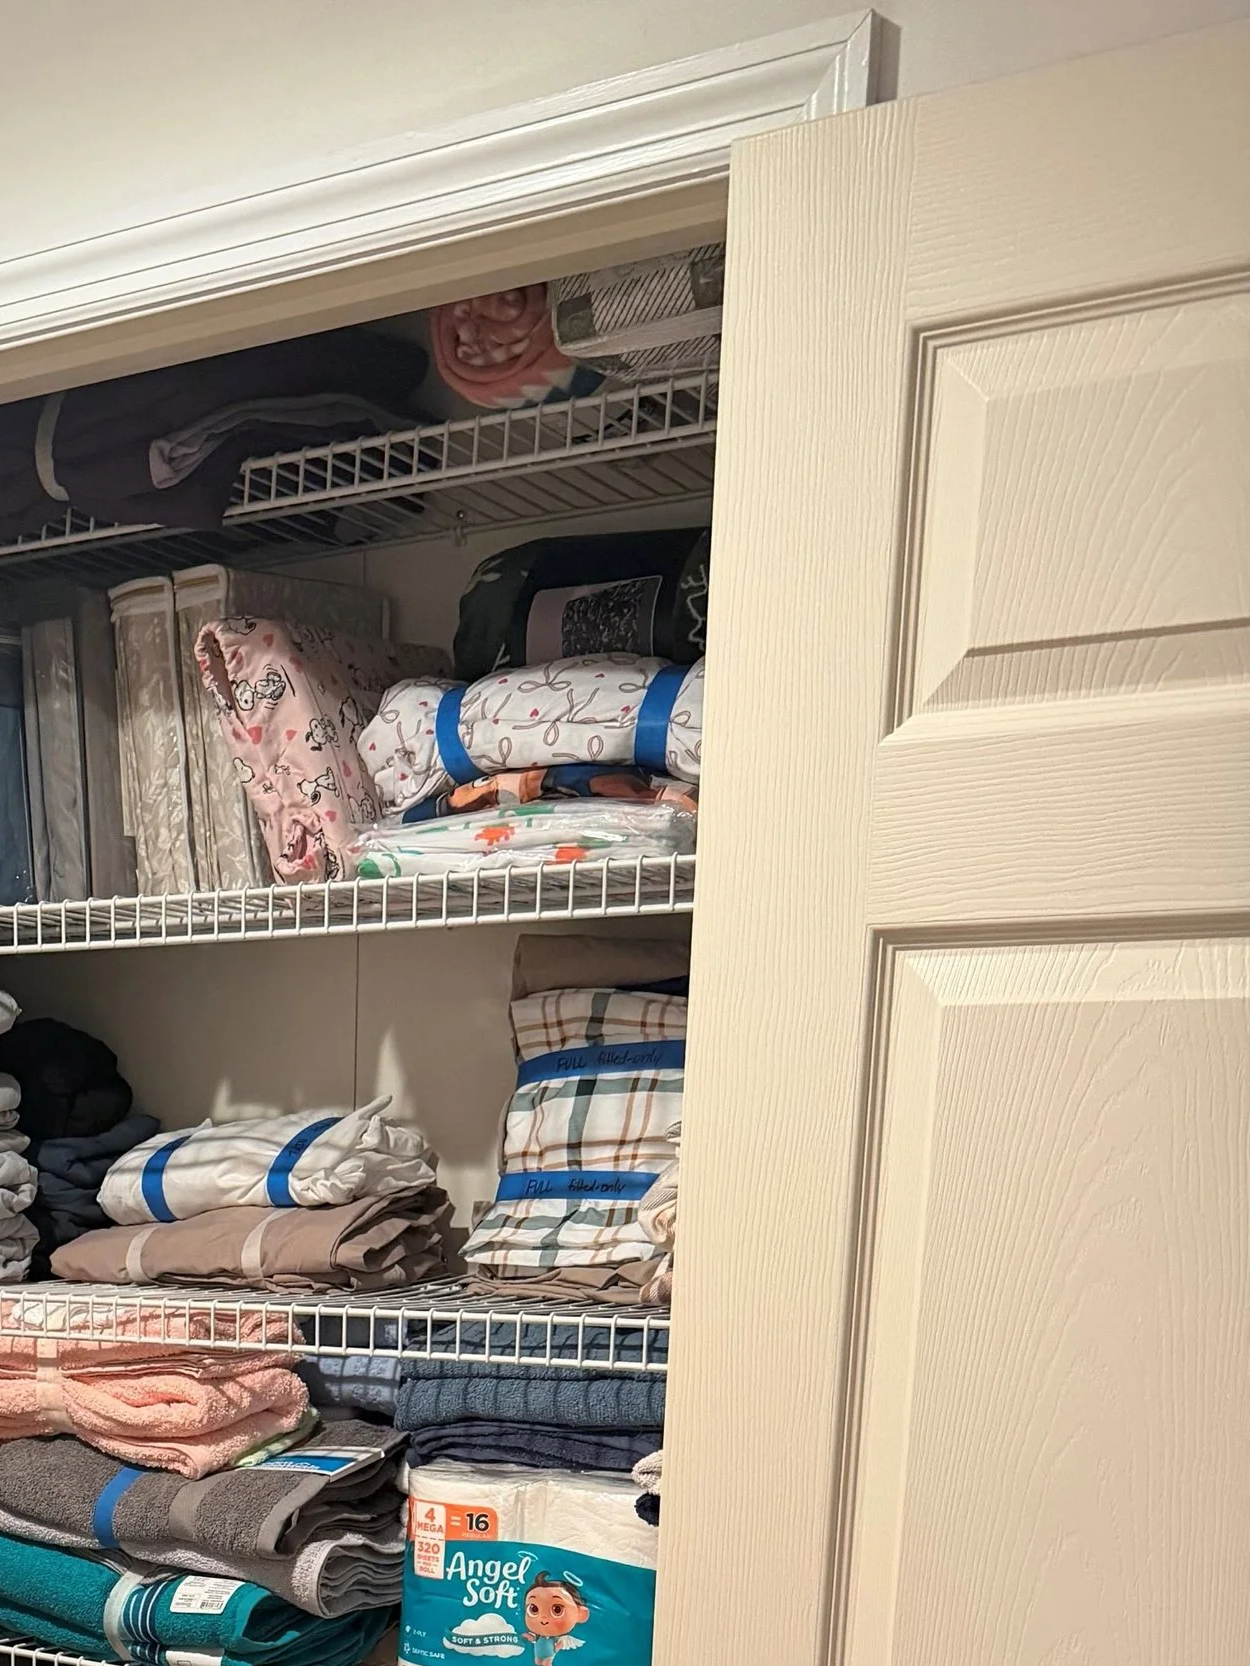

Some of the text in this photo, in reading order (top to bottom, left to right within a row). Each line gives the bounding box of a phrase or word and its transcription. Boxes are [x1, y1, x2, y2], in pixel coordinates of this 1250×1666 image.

[557, 1056, 587, 1071] FULL
[526, 1178, 553, 1195] FULL
[424, 1507, 436, 1522] 4
[466, 1512, 490, 1532] 16
[417, 1520, 444, 1534] MEGA
[417, 1541, 441, 1555] 320
[417, 1553, 440, 1563] SHEETS
[419, 1566, 436, 1574] ROLL
[446, 1551, 527, 1585] Angel
[462, 1578, 518, 1609] Soft
[452, 1634, 519, 1645] SOFT & STRONG
